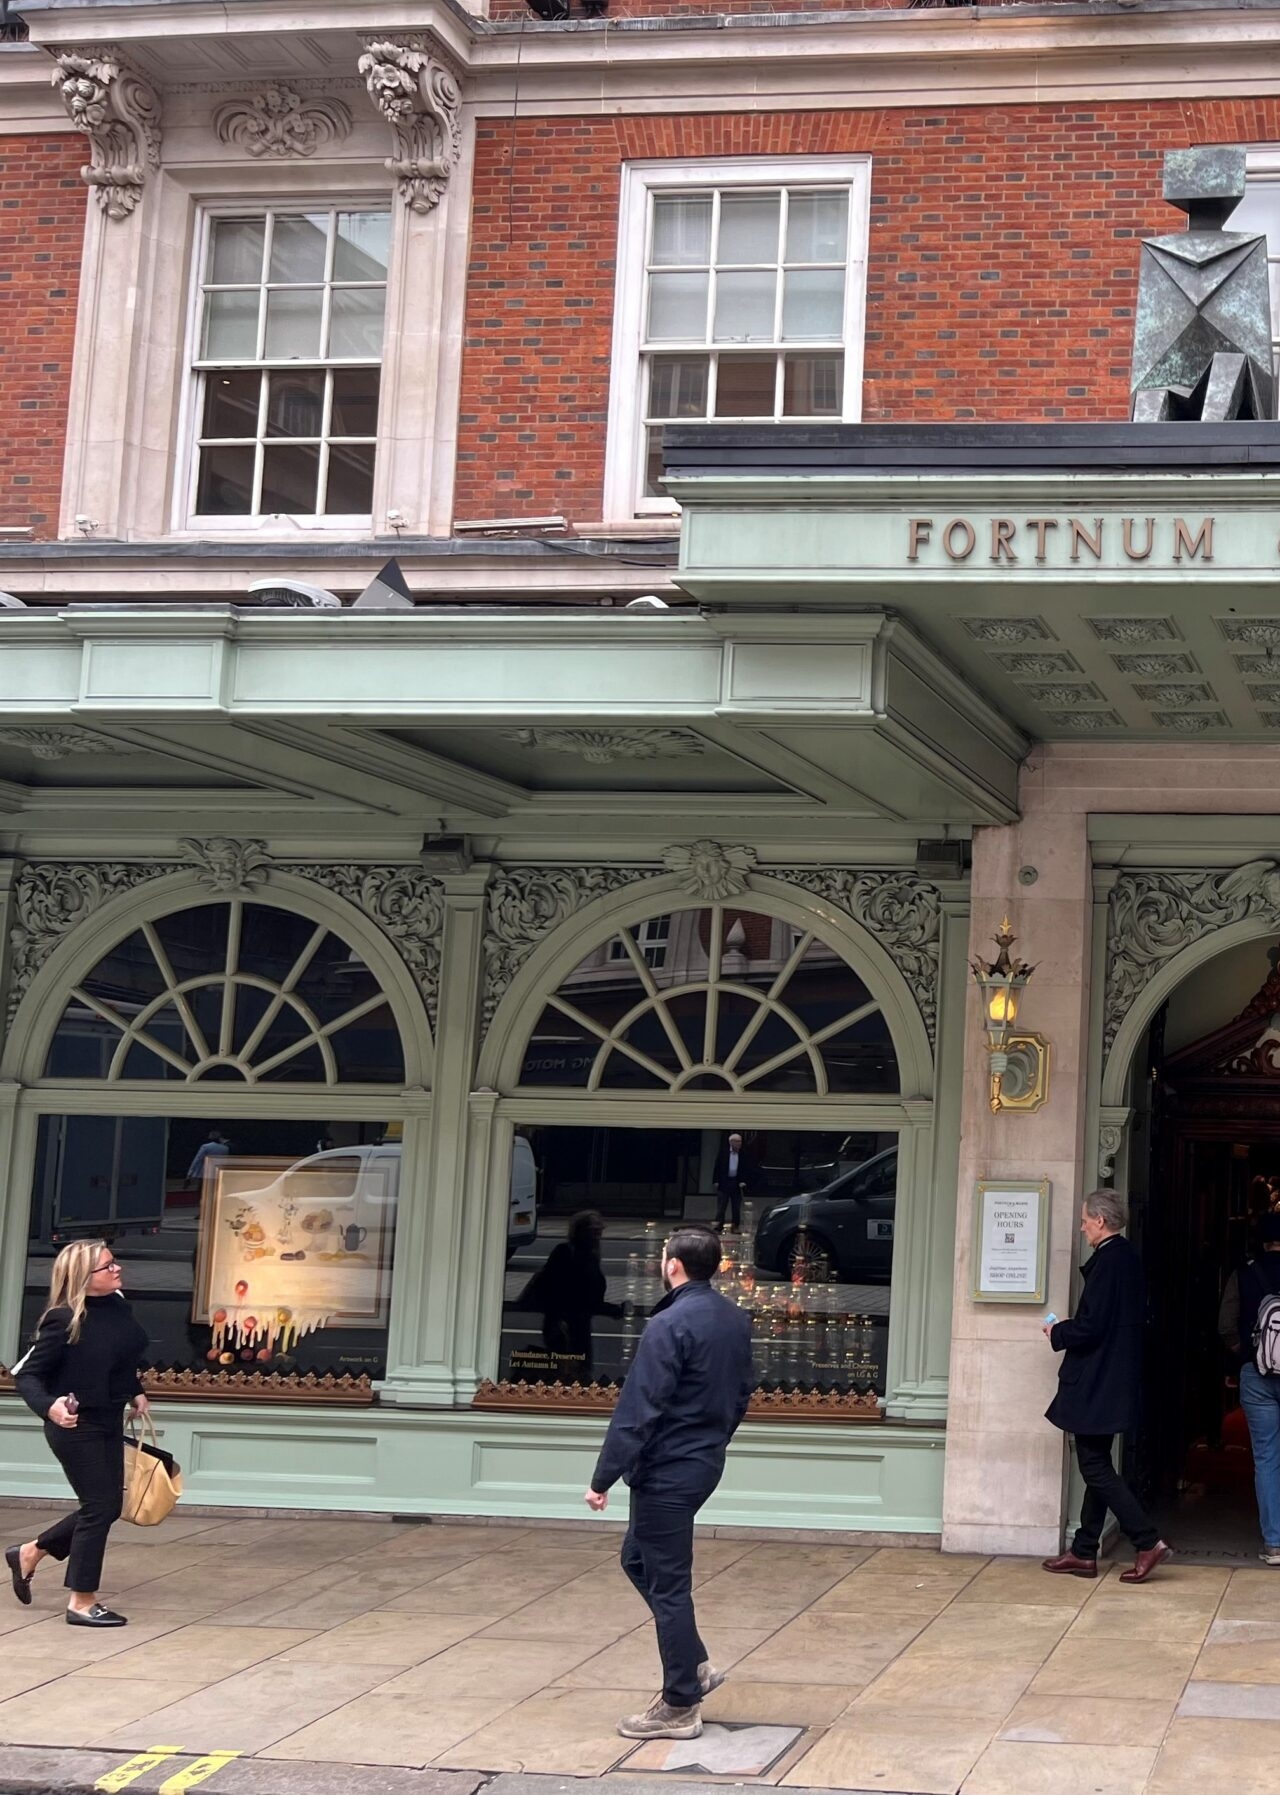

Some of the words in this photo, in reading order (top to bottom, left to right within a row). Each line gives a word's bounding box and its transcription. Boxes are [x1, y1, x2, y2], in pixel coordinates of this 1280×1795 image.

[907, 517, 1215, 560] FORTNUM
[993, 1211, 1028, 1220] OPENING
[997, 1221, 1024, 1229] HOURS
[511, 1350, 549, 1359] Abundance,
[551, 1351, 586, 1361] Preserved
[508, 1359, 520, 1368] Let
[521, 1360, 549, 1369] Autumn
